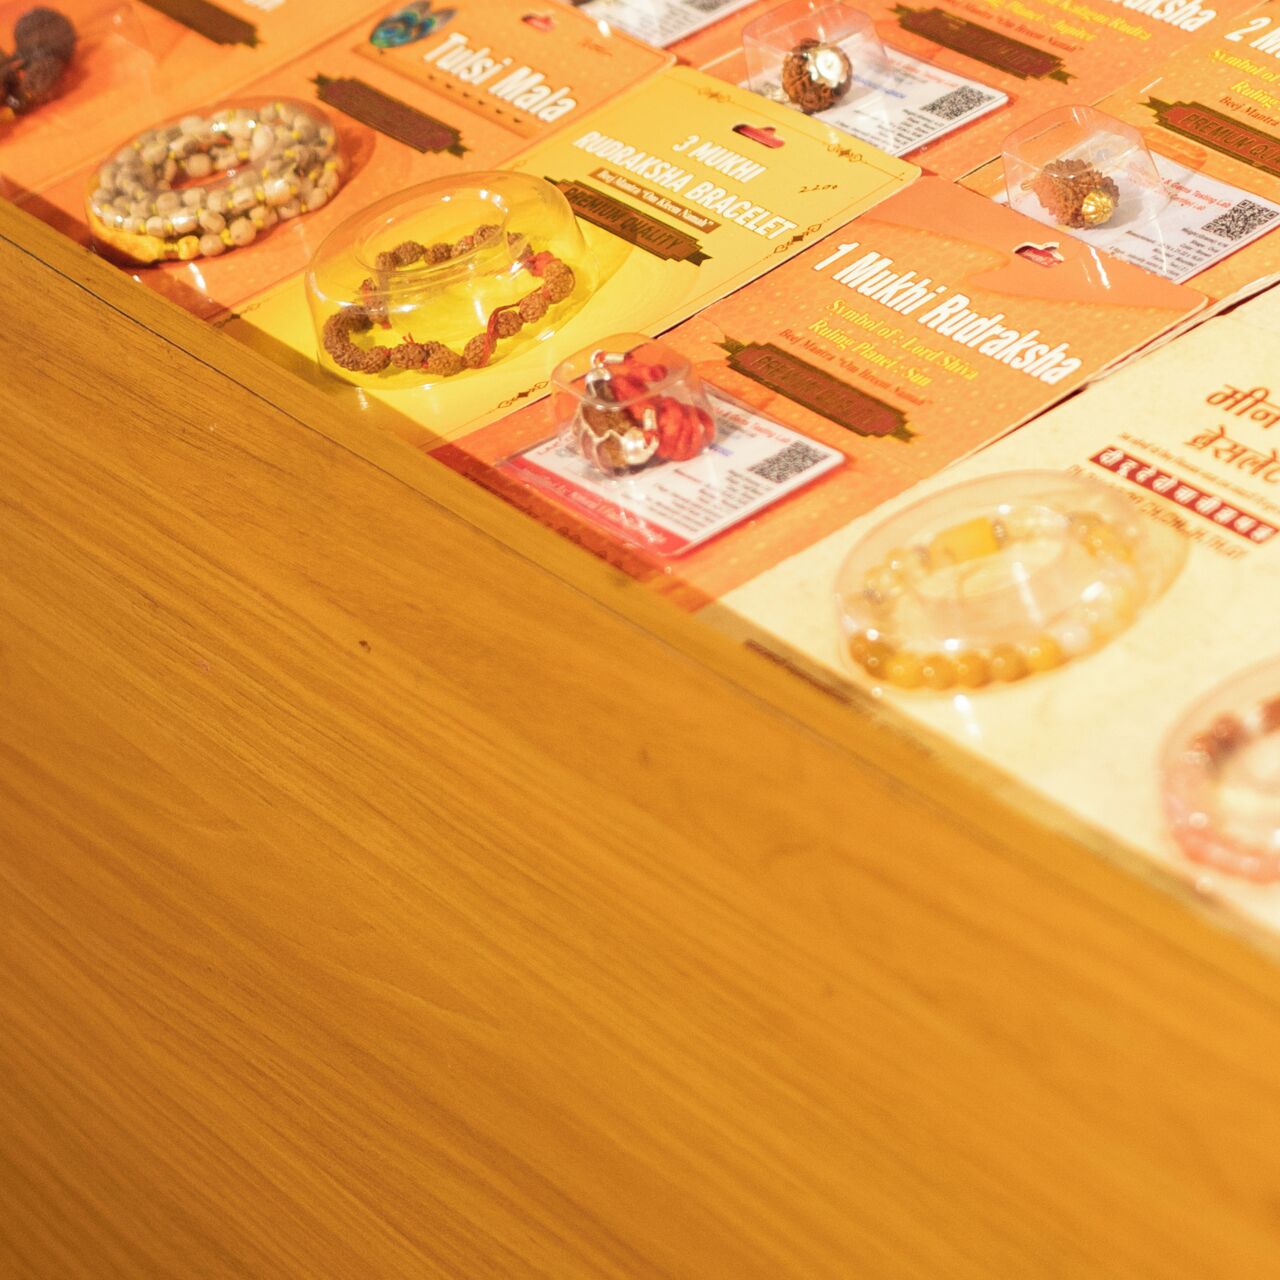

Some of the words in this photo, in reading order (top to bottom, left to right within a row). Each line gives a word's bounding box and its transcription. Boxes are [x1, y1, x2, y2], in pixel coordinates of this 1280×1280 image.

[1224, 17, 1271, 41] 2
[423, 32, 513, 86] Tulsi
[487, 65, 577, 122] Mala
[1209, 48, 1265, 76] Symbol
[1219, 95, 1242, 114] Beej
[1241, 106, 1280, 127] Mantra
[1230, 79, 1280, 110] Ruling
[672, 134, 700, 152] 3
[687, 141, 767, 184] MUKHI
[572, 130, 695, 193] RUDRAKSHA
[683, 181, 798, 240] BRACELET
[619, 215, 682, 250] QUALITY
[813, 242, 860, 272] 1
[833, 251, 945, 316] Mukhi
[808, 319, 853, 351] Ruling
[851, 341, 898, 373] Planet
[902, 367, 933, 387] Sun
[827, 299, 879, 332] Symbol
[901, 336, 945, 362] Lord
[938, 351, 979, 381] Shiva
[918, 293, 1082, 385] Rudraksha
